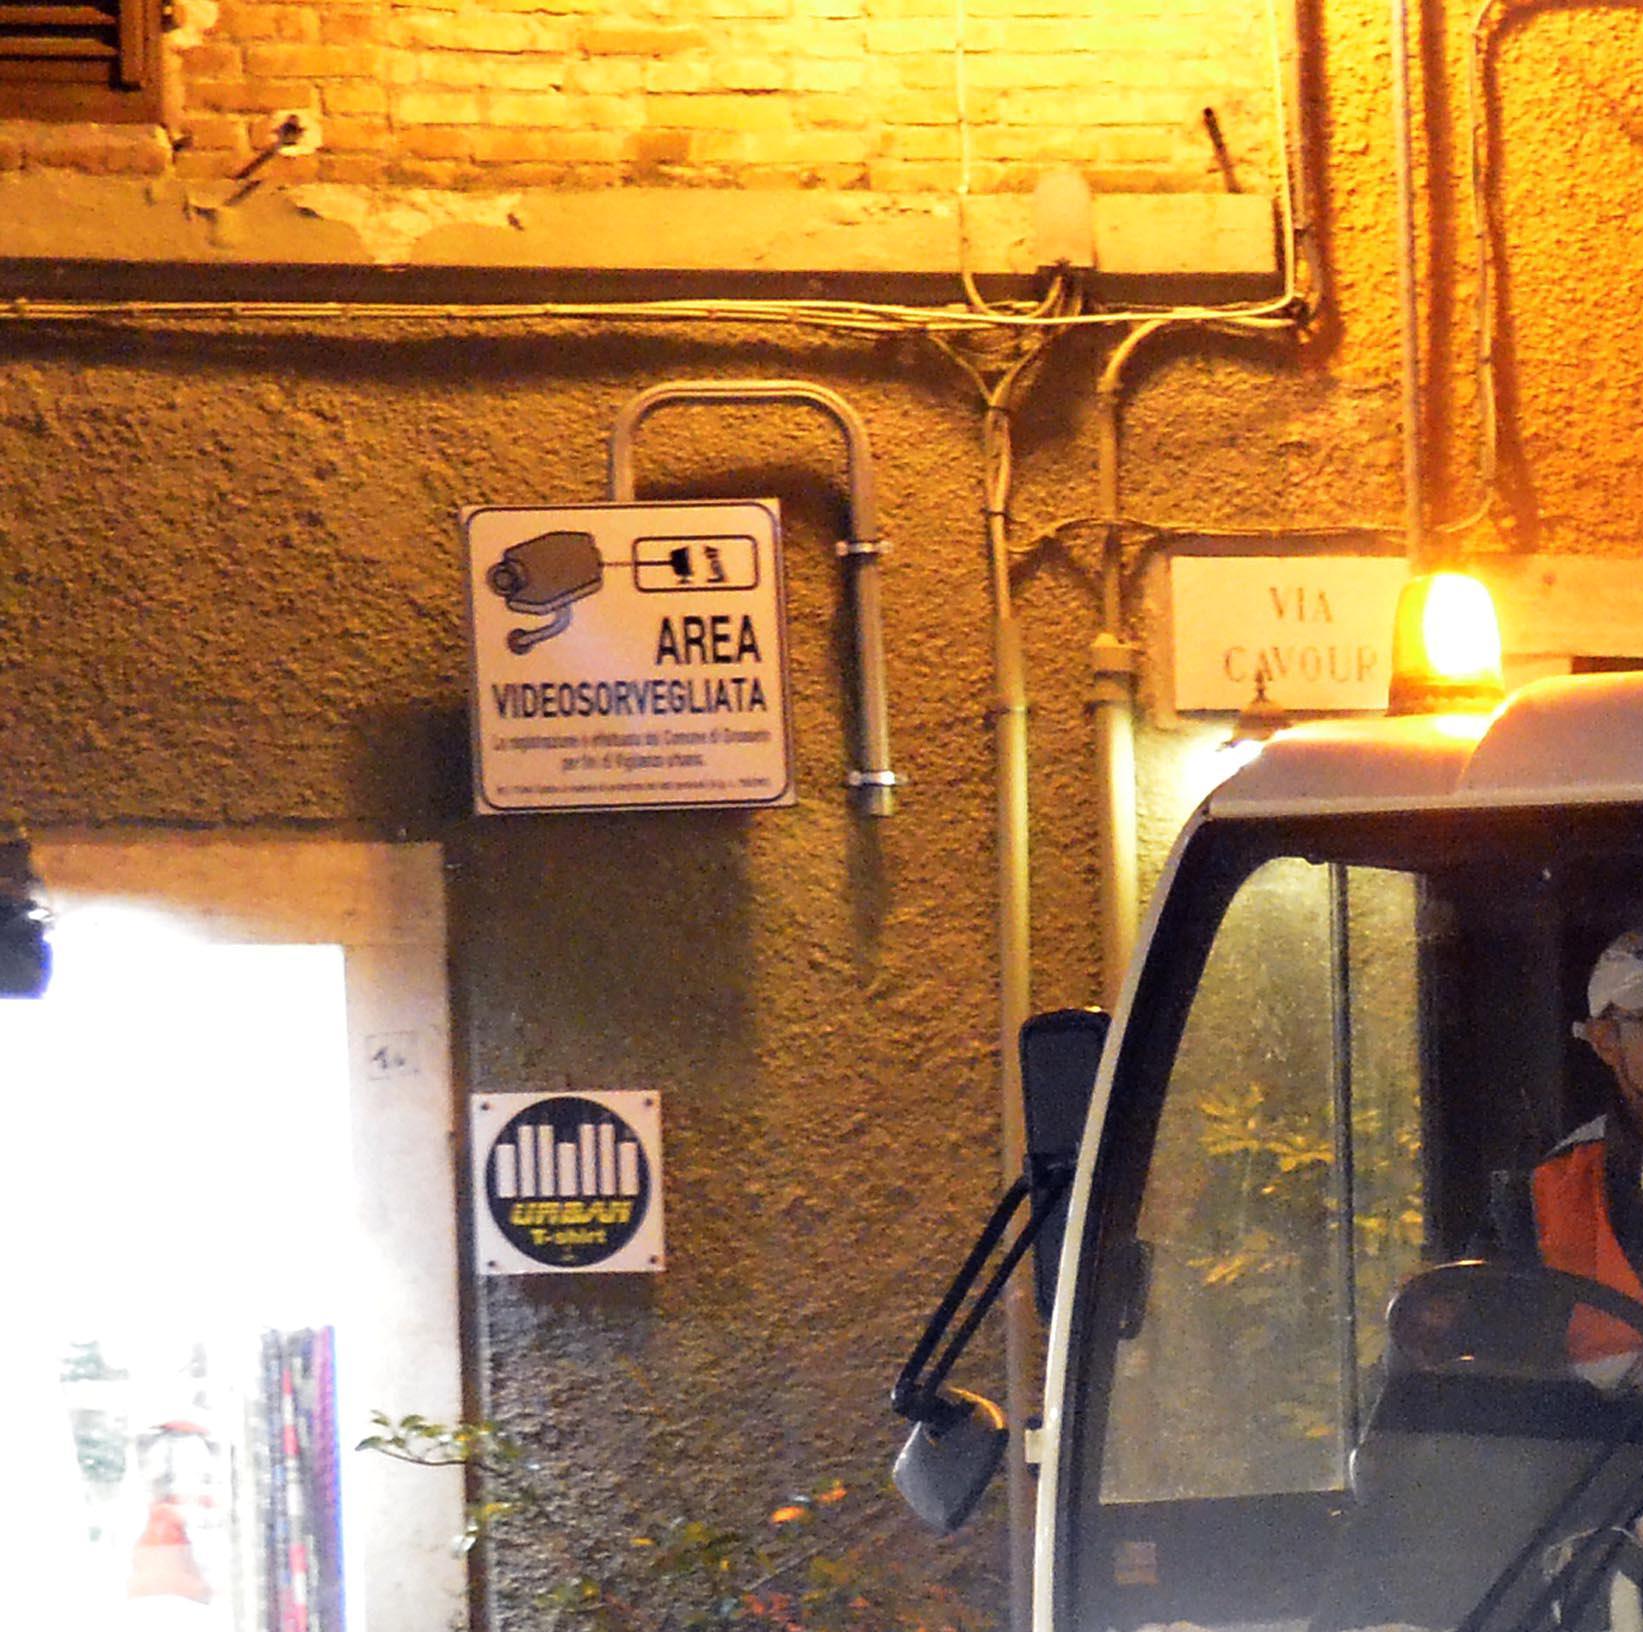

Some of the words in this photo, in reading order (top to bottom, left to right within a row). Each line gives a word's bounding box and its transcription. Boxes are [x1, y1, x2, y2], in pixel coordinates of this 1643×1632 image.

[1267, 585, 1335, 623] VIA
[655, 614, 762, 666] AREA
[1222, 644, 1379, 684] CAVOUR
[490, 677, 769, 720] VIDEOSORVEGLIATA
